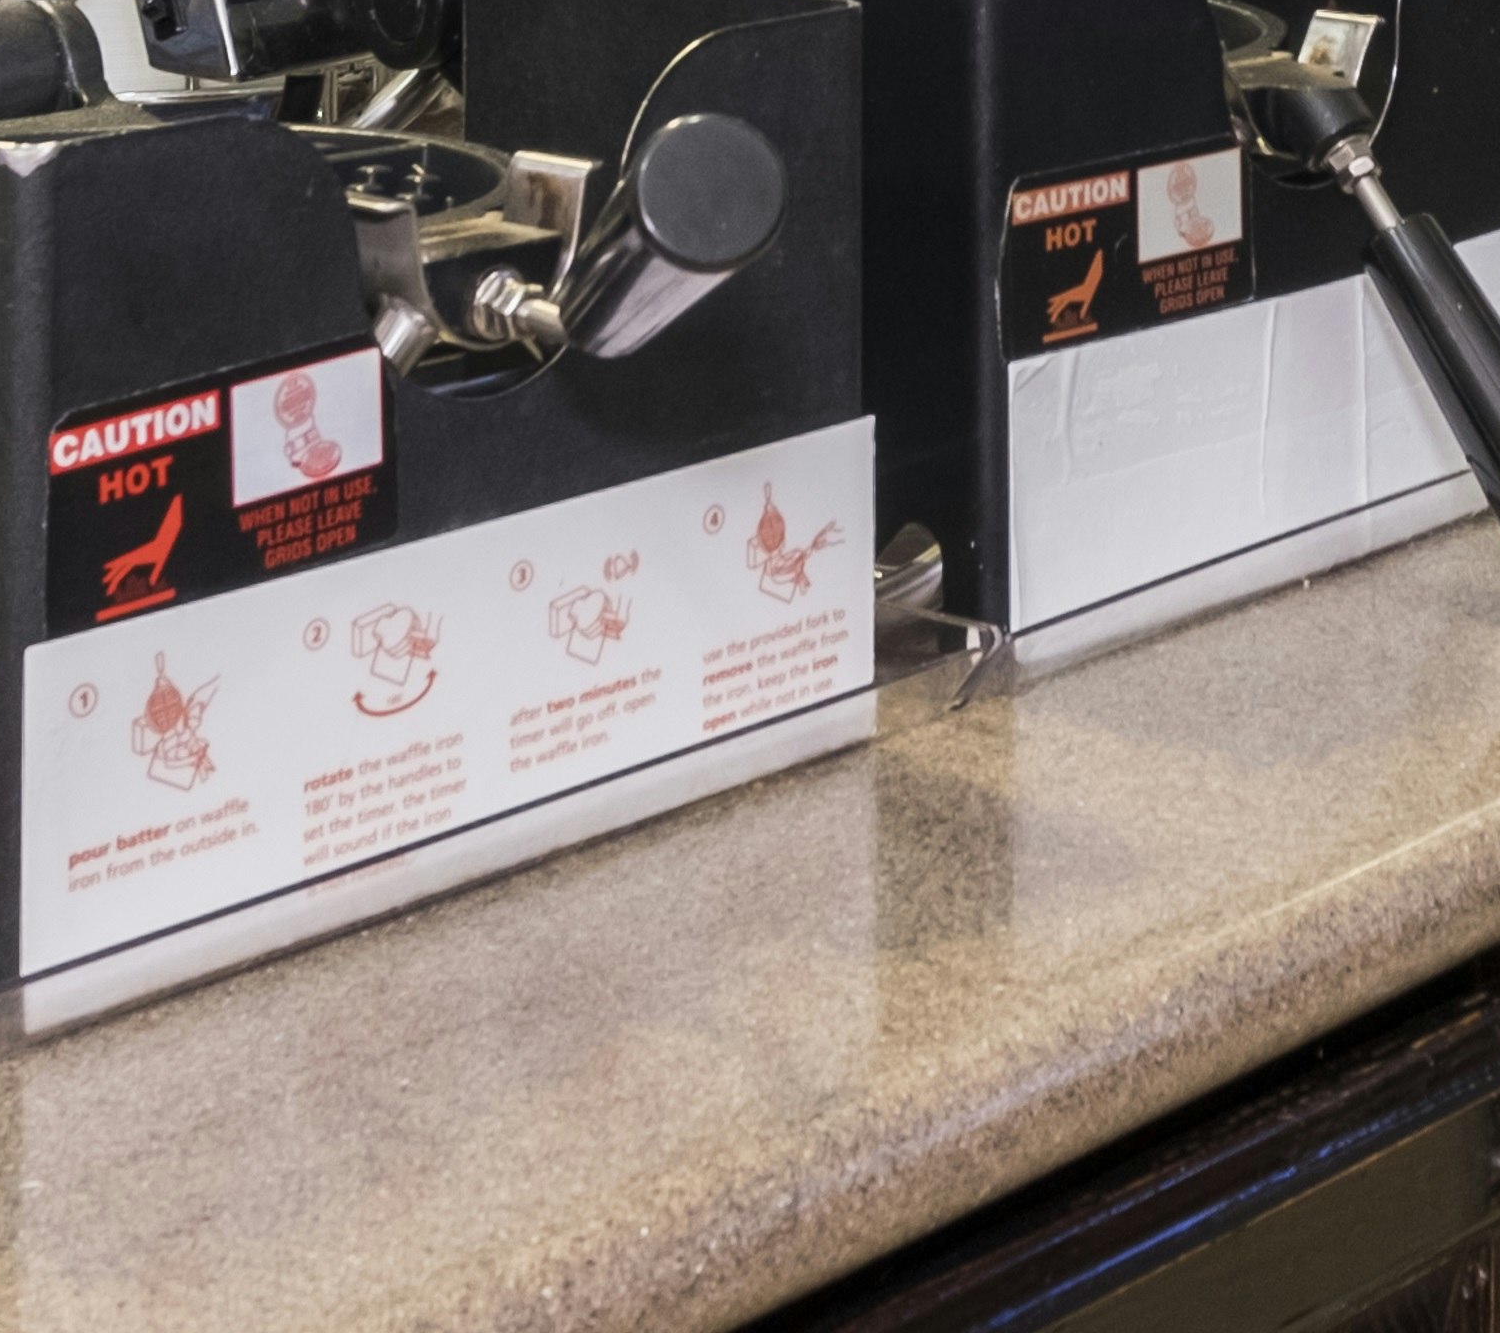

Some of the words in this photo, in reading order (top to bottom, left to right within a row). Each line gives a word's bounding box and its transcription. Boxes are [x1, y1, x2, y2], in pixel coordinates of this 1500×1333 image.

[1014, 177, 1127, 220] CAUTION
[1046, 218, 1097, 251] HOT
[1142, 264, 1176, 283] WHEN
[1177, 258, 1198, 275] NOT
[1201, 254, 1213, 268] IN
[1155, 276, 1195, 298] PLEASE
[1197, 267, 1229, 287] LEAVE
[1160, 295, 1194, 314] GRIDS
[1196, 285, 1225, 305] OPEN
[53, 395, 217, 468] CAUTION
[99, 455, 174, 505] HOT
[239, 500, 286, 531] WHEN
[289, 493, 320, 521] NOT
[323, 486, 340, 507] IN
[257, 517, 313, 548] PLEASE
[317, 501, 362, 528] LEAVE
[709, 511, 719, 528] 4
[265, 541, 311, 569] GRIDS
[316, 529, 356, 553] OPEN
[703, 647, 725, 665] use
[727, 638, 748, 657] the
[750, 620, 803, 652] provided
[805, 612, 830, 631] fork
[832, 608, 846, 622] to
[703, 660, 753, 685] remove
[756, 650, 777, 668] the
[779, 636, 818, 660] waffle
[819, 628, 850, 647] from
[79, 691, 89, 710] 1
[509, 704, 543, 727] after
[546, 695, 575, 715] two
[579, 676, 638, 704] minutes
[640, 666, 663, 684] the
[702, 690, 724, 709] the
[756, 672, 787, 694] keep
[789, 663, 811, 681] the
[812, 654, 838, 672] iron
[509, 728, 546, 750] timer
[549, 717, 574, 737] will
[576, 713, 594, 731] go
[622, 691, 657, 714] open
[702, 710, 737, 732] open
[739, 699, 774, 719] while
[775, 692, 798, 710] not
[798, 686, 811, 700] in
[304, 767, 353, 794] rotate
[358, 758, 382, 776] the
[386, 741, 430, 766] waffle
[435, 732, 463, 751] iron
[509, 752, 532, 773] the
[536, 737, 578, 764] waffle
[328, 816, 353, 834] the
[402, 792, 427, 810] the
[430, 778, 468, 802] timer
[338, 791, 356, 809] by
[360, 782, 384, 800] the
[387, 763, 443, 791] handles
[446, 756, 462, 772] to
[68, 843, 110, 871] pour
[116, 821, 171, 851] batter
[174, 816, 197, 834] on
[201, 796, 249, 824] waffle
[303, 844, 330, 867] will
[333, 828, 378, 857] sound
[381, 822, 393, 841] if
[396, 817, 420, 836] the
[423, 807, 452, 827] iron
[68, 867, 101, 893] iron
[106, 855, 146, 881] from
[149, 844, 176, 868] the
[180, 827, 238, 858] outside
